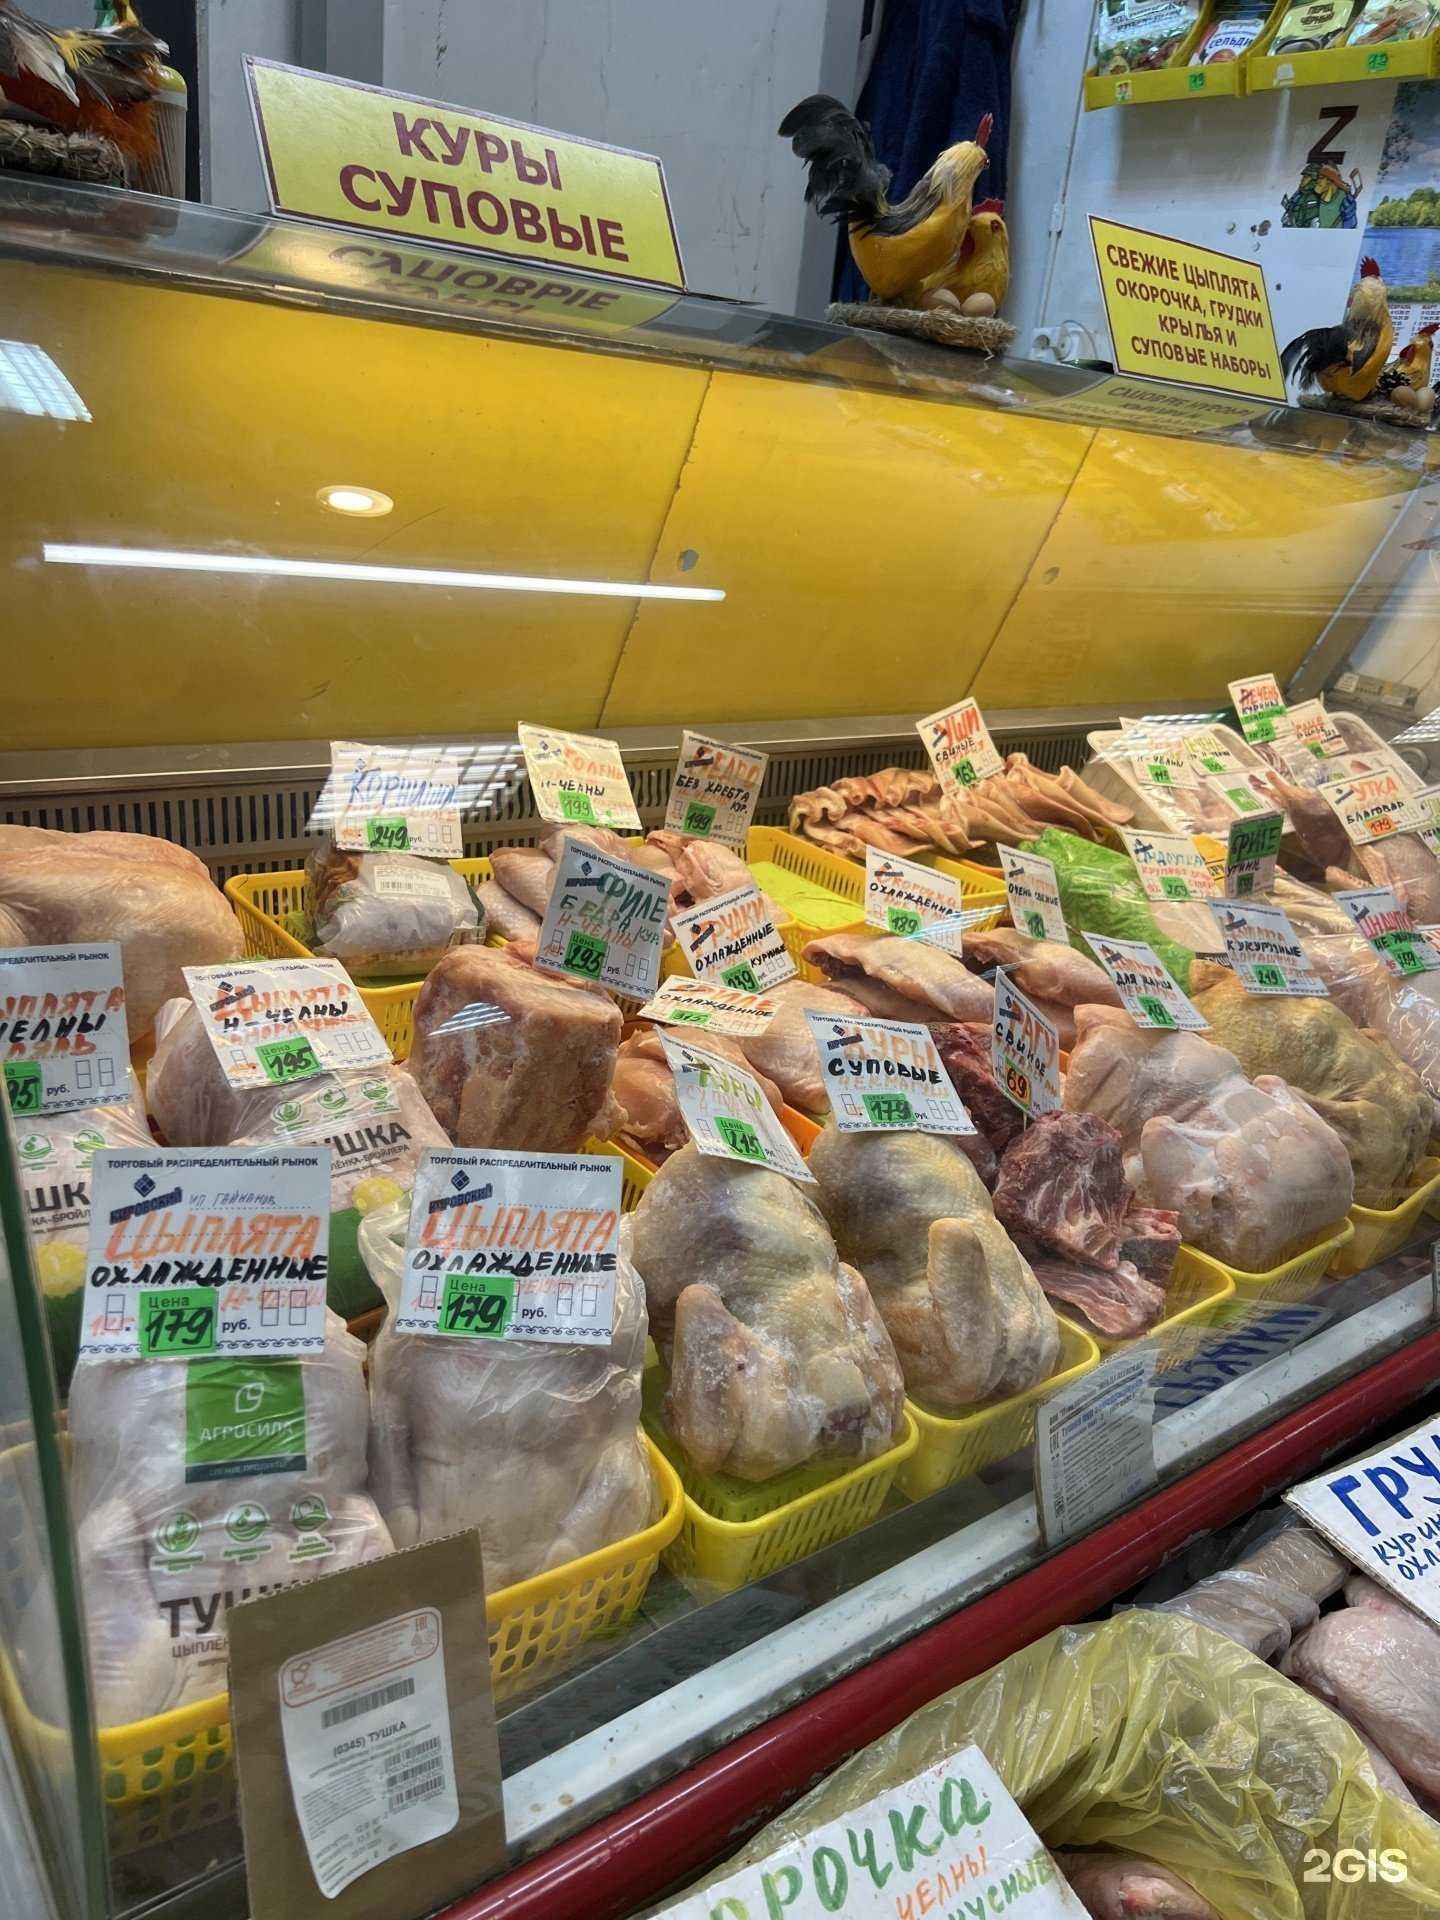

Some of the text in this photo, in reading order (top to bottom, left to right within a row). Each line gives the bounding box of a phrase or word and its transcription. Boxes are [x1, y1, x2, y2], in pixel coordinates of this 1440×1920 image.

[392, 111, 562, 191] КУРЫ
[1307, 105, 1359, 165] Z
[339, 164, 629, 263] СУПОВЫЕ
[1106, 244, 1260, 303] СВЕЖИЕ ЦЫПЛЯТА
[1115, 278, 1264, 329] ОКОРОЧКА, ГРУДКИ
[1158, 314, 1237, 348] КРЫЛЬЯ И
[1131, 336, 1271, 380] СУПОВЫЕ НАБОРЫ
[705, 780, 750, 802] ХРЕБТА
[370, 825, 408, 850] 249
[596, 871, 667, 924] ФИЛЕ
[890, 915, 919, 934] 189
[695, 923, 775, 971] ОХЛАЖДЕННЫЕ
[659, 994, 774, 1017] ОХЛАЖДЕННОЕ
[828, 1058, 943, 1084] СУПОВЫЕ
[46, 1085, 71, 1096] руб.
[325, 1121, 412, 1156] ШКА
[108, 1157, 318, 1169] ТОРГОВЫЙ РАСПРЕДЕЛИТЕЛЬНЫЙ РЫНОК
[430, 1156, 612, 1173] ТОРГОВЫЙ РАСПРЕДЕЛИТЕЛЬНЫЙ РЫНОК
[105, 1210, 321, 1270] ЦЫПЛЯТА
[419, 1203, 618, 1260] ЦЫПЛЯТА
[91, 1255, 328, 1288] ОХЛАЖДЕННЫЕ
[411, 1249, 617, 1277] ОХЛАЖДЕННЫЕ
[148, 1296, 190, 1310] Цена
[450, 1279, 486, 1293] Цена
[145, 1306, 214, 1349] 179
[222, 1319, 251, 1334] руб.
[448, 1294, 507, 1333] 179
[522, 1307, 547, 1319] руб.
[201, 1420, 294, 1442] АГРОСИЛА
[1327, 1434, 1440, 1537] ГРУ
[1397, 1540, 1440, 1580] ОХЛ
[368, 1720, 408, 1743] ТУШКА
